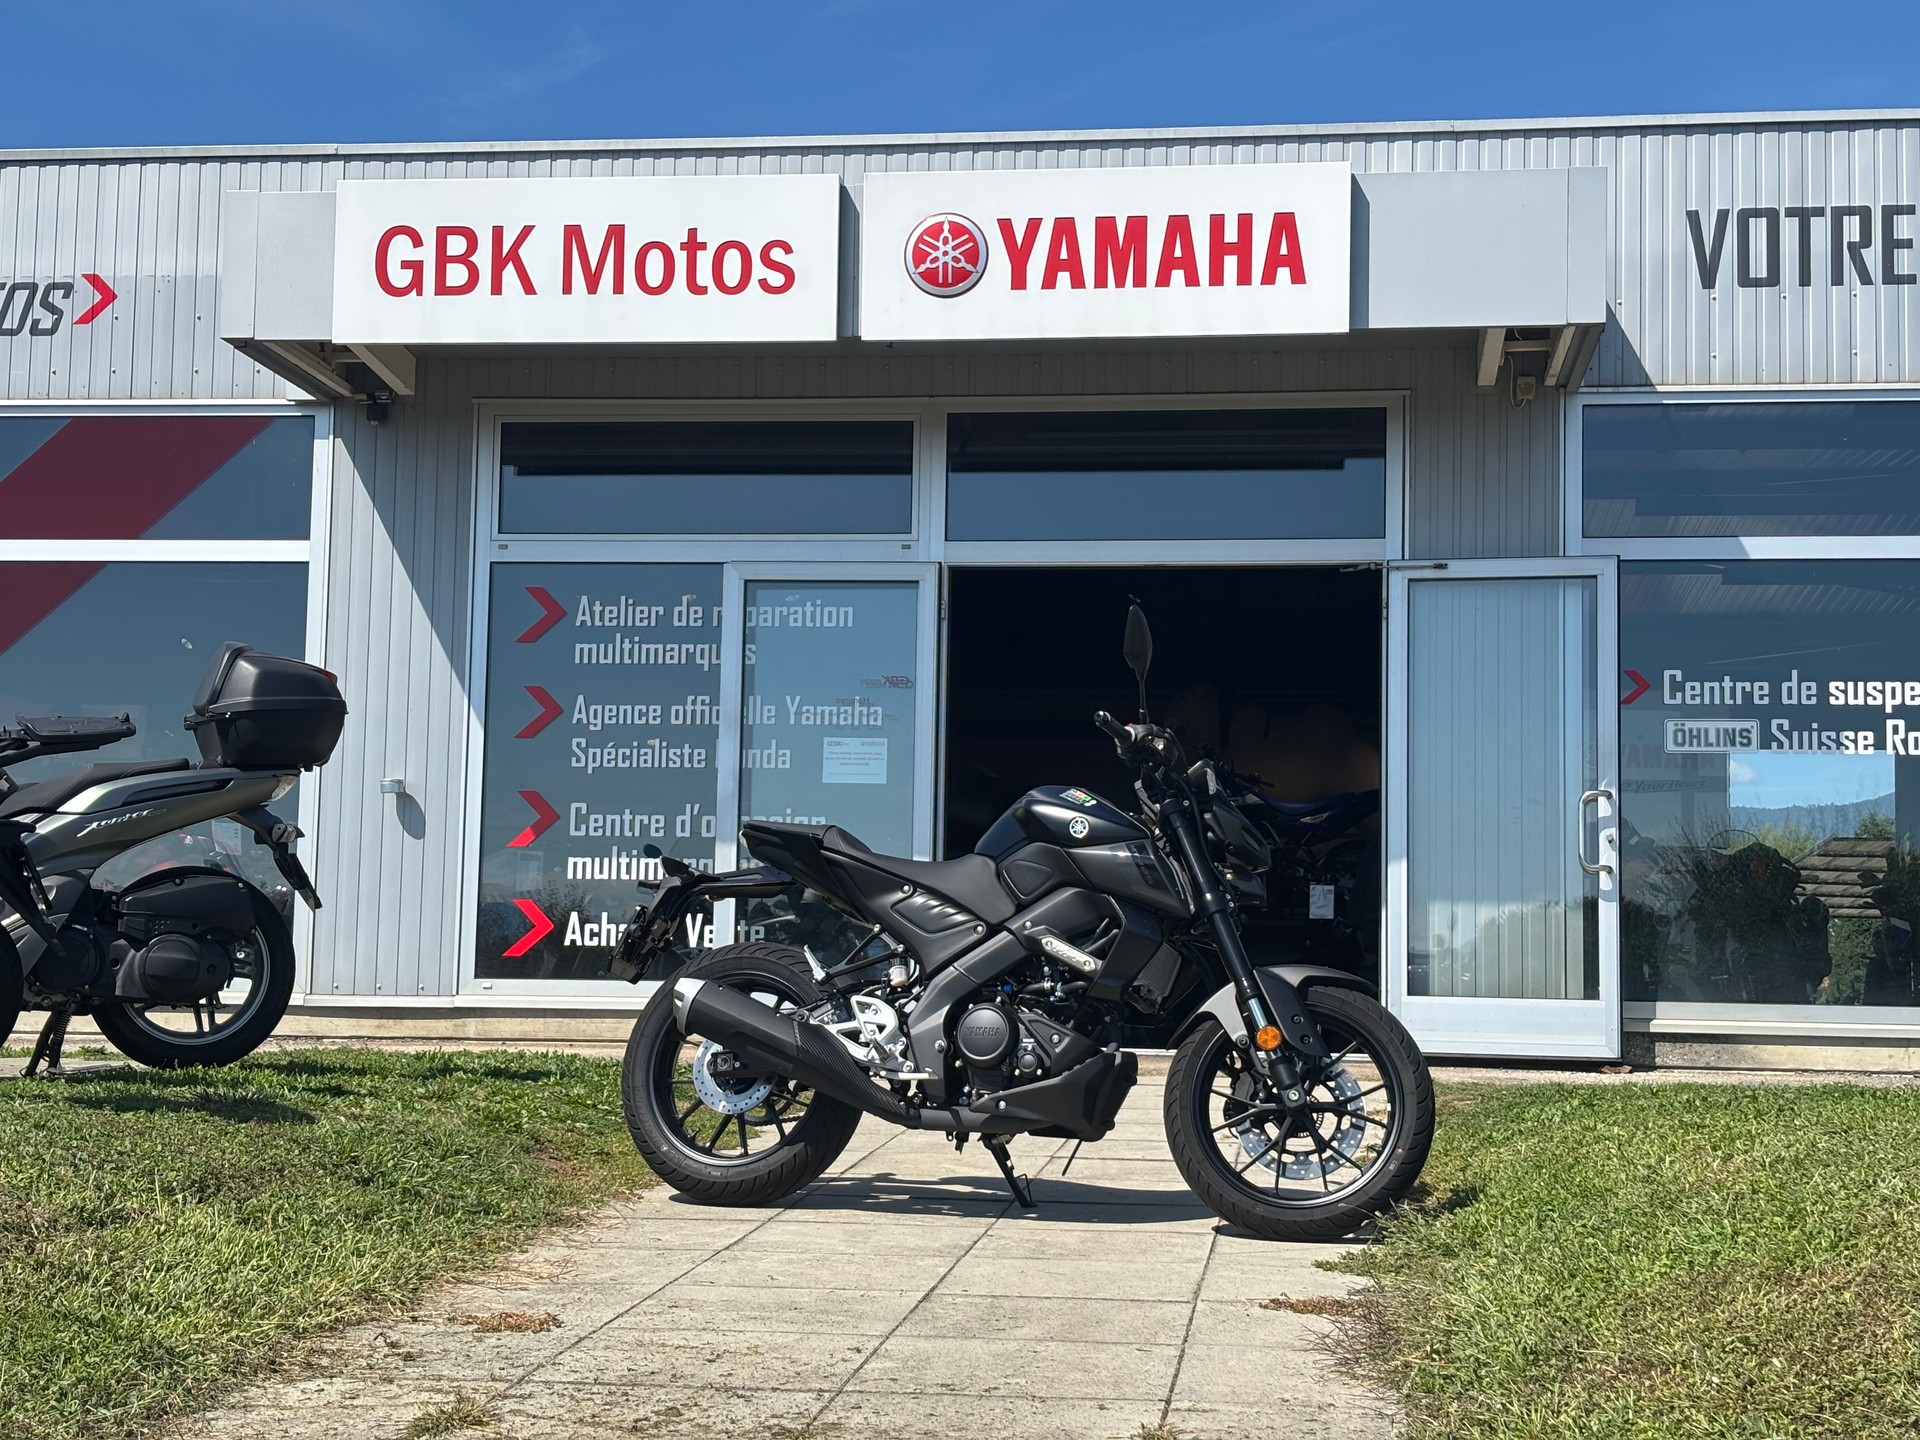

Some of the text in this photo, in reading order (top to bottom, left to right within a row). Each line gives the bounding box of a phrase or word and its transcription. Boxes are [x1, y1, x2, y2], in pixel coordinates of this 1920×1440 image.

[374, 223, 796, 297] GBK Motos
[996, 211, 1307, 291] YAMAHA
[1685, 204, 1918, 290] VOTRE
[0, 281, 74, 336] OS
[575, 595, 853, 634] Atelier de rparation
[575, 633, 757, 671] multimarqus
[1663, 669, 1920, 713] Centre de suspe
[572, 694, 883, 731] Agence officlle Yamaha
[1672, 718, 1920, 755] ÖHLINS Suisse Ro
[571, 737, 707, 774] Spécialiste
[715, 739, 791, 769] nda
[1621, 743, 1716, 769] AMAHA
[569, 802, 666, 838] Centre
[685, 912, 765, 948] Vete
[965, 1026, 1001, 1038] YAMAHA
